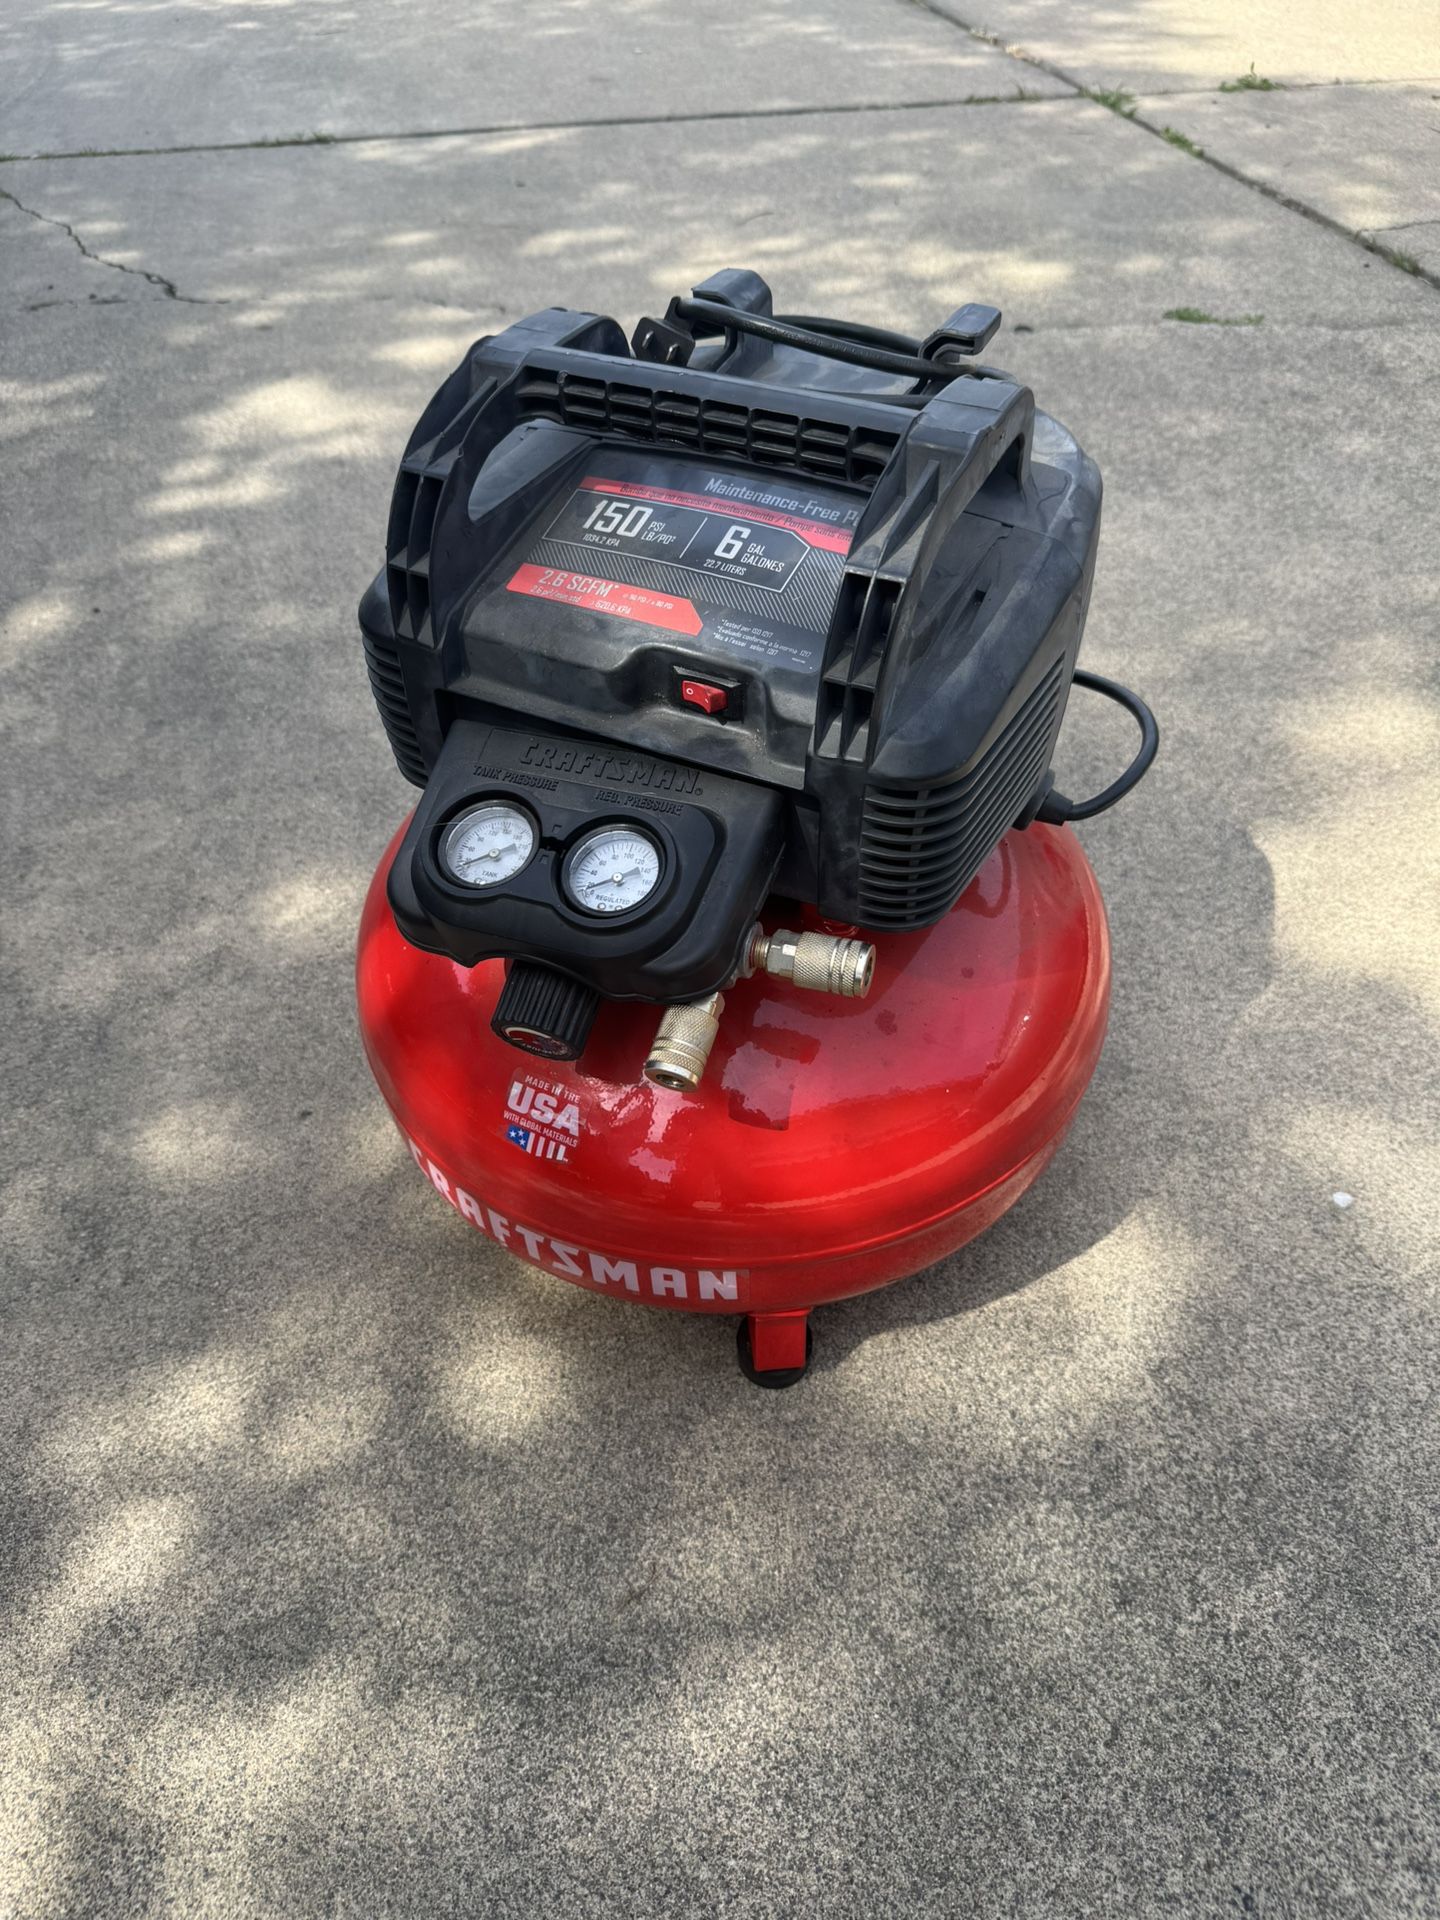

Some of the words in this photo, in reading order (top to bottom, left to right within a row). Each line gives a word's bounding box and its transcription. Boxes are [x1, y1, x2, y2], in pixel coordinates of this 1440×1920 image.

[704, 478, 841, 522] Maintenance-Free
[582, 499, 654, 538] 150
[648, 521, 666, 532] PSI
[605, 537, 621, 547] KPA
[714, 524, 752, 560] 6
[747, 542, 766, 556] GAL
[703, 558, 721, 570] 22.7
[720, 562, 747, 576] LITERS
[741, 554, 785, 573] GALONES
[538, 569, 568, 588] 2.6
[473, 765, 502, 780] TANK
[502, 771, 560, 792] PRESSURE
[595, 790, 620, 804] REG.
[624, 795, 684, 817] PRESSURE
[482, 870, 498, 878] TANK
[595, 893, 631, 906] REGULATED
[524, 1075, 551, 1091] MADE
[551, 1085, 563, 1096] IN
[563, 1090, 581, 1104] THE
[507, 1080, 580, 1137] USA
[503, 1110, 520, 1123] WITH
[519, 1117, 542, 1133] GLOBAL
[542, 1127, 579, 1148] MATERIALS
[408, 1138, 739, 1300] CRAFTSMAN
